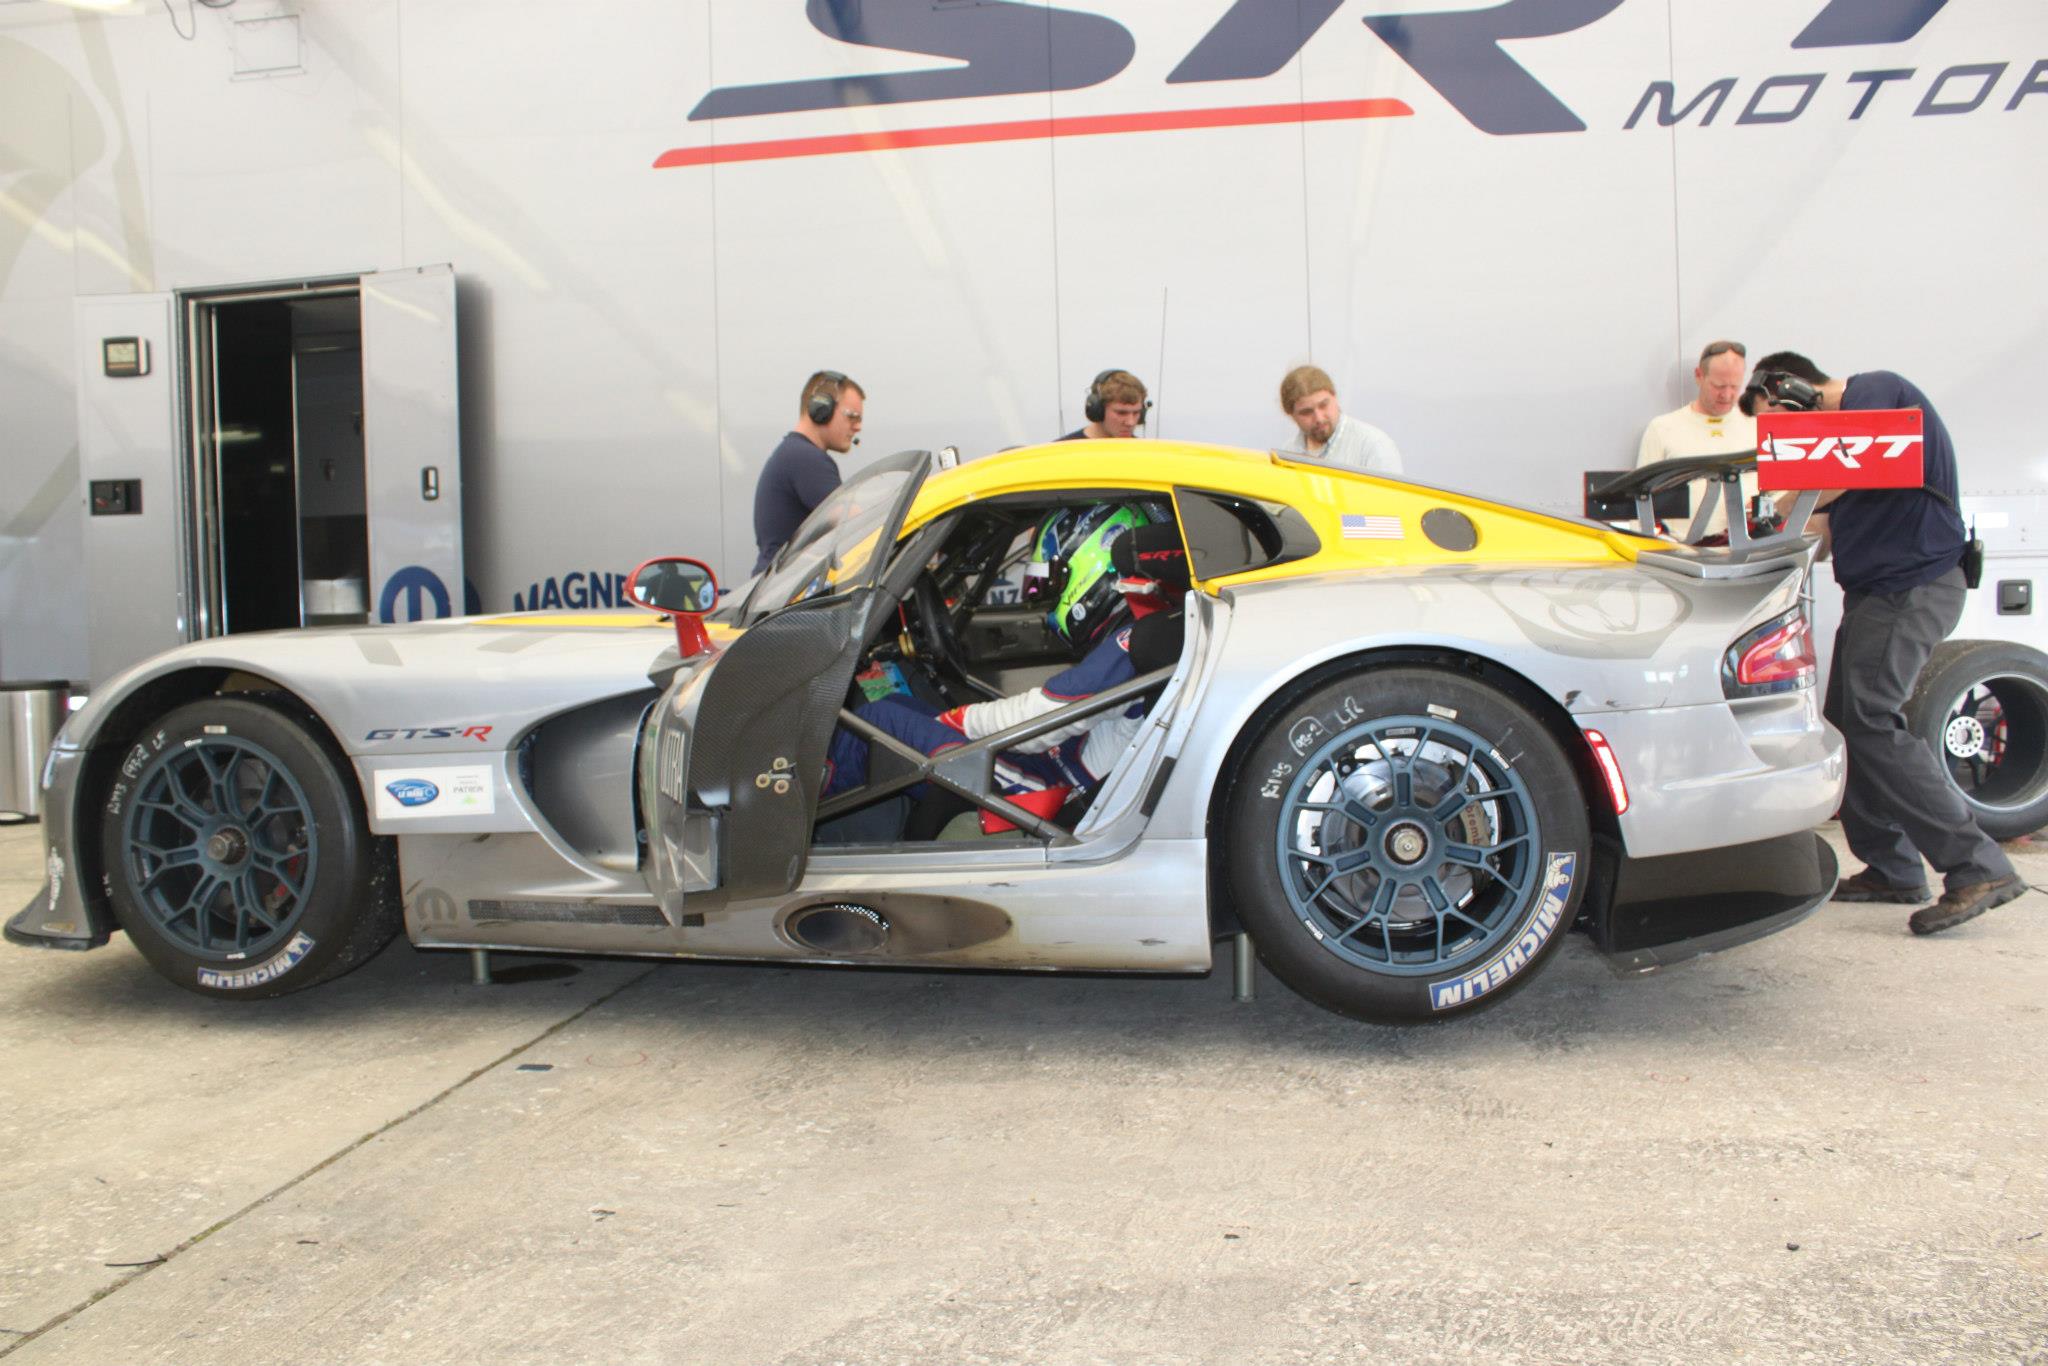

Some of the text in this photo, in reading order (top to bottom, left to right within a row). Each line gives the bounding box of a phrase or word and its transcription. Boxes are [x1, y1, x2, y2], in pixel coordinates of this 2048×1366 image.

[1757, 433, 1923, 469] SRT
[365, 725, 493, 742] GTS-R
[1437, 892, 1564, 1007] MICHELIN
[200, 952, 293, 988] MICHELIN
